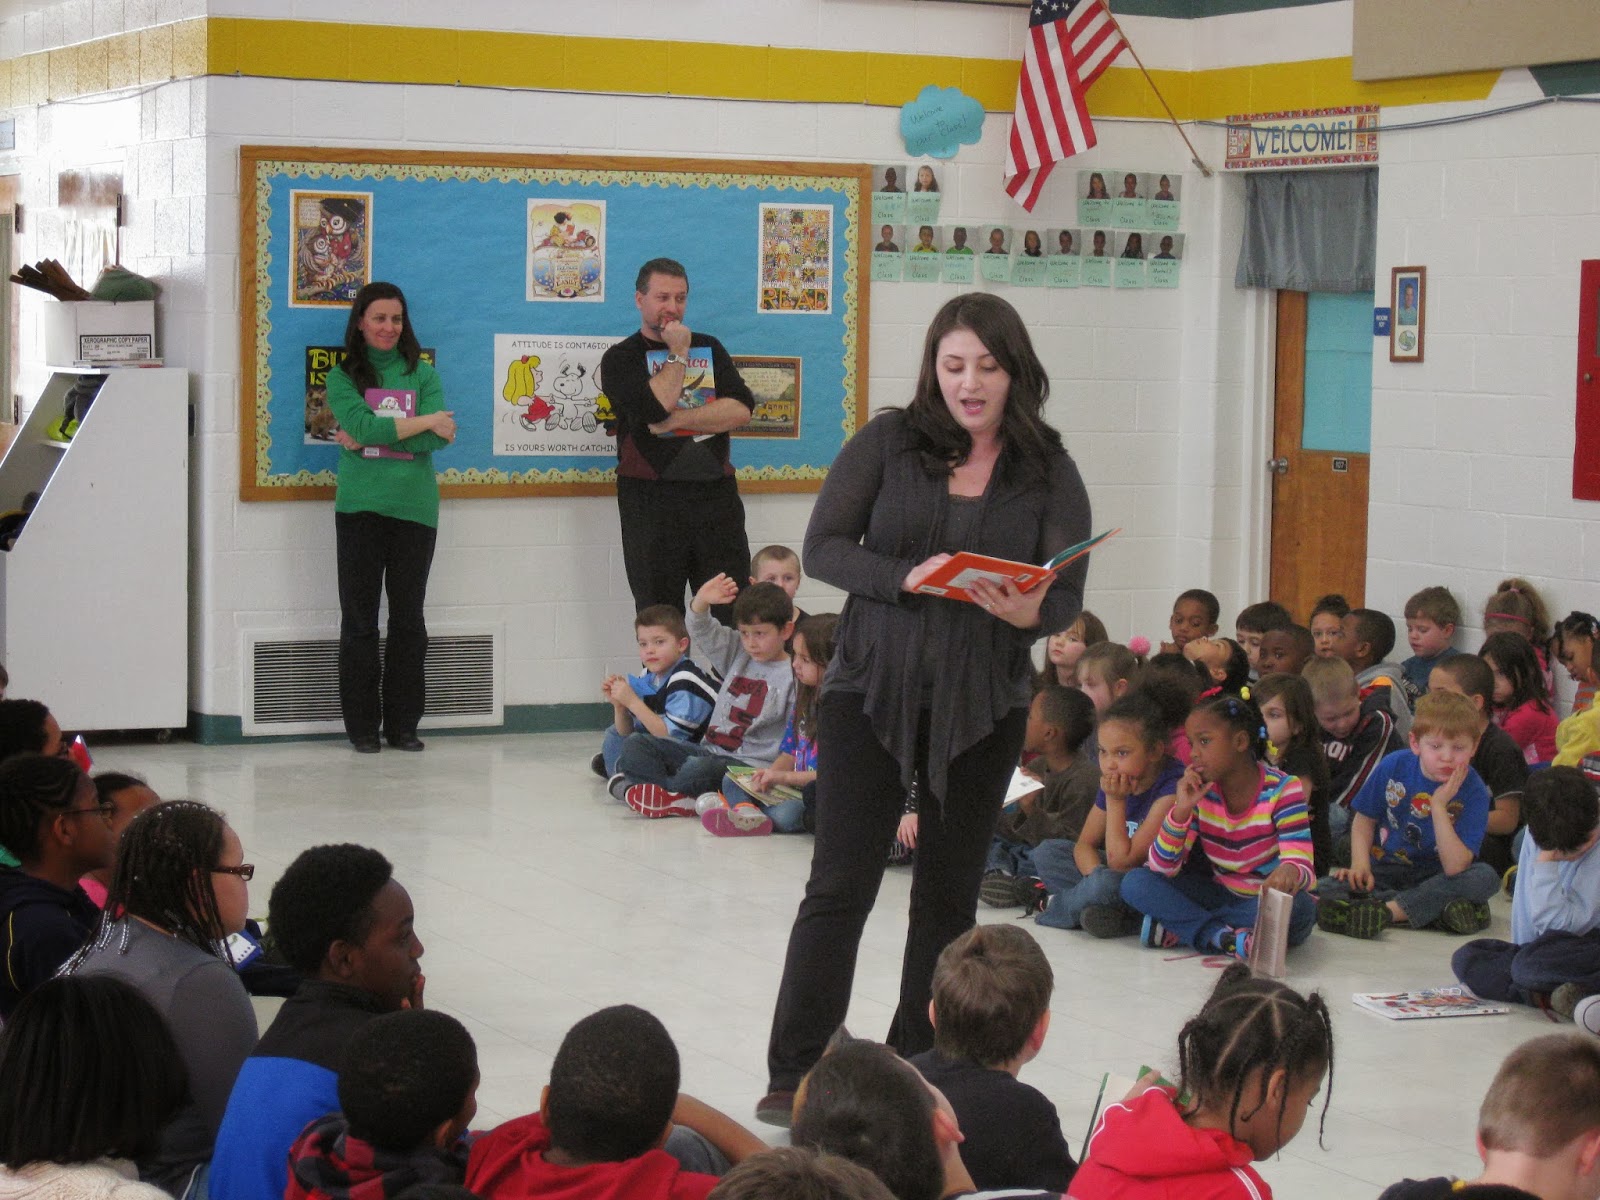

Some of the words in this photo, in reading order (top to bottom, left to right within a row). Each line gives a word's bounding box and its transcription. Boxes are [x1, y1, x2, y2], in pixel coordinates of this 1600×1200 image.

[910, 105, 944, 124] Welcome
[935, 120, 945, 129] to
[1253, 120, 1353, 156] WELCOME!
[761, 288, 829, 311] READ
[511, 340, 552, 349] ATTITUDE
[554, 341, 564, 349] IS
[565, 342, 616, 350] CONTAGIOU
[517, 444, 545, 452] YOURS
[547, 444, 578, 452] WORTH
[580, 444, 617, 452] CATCHIN
